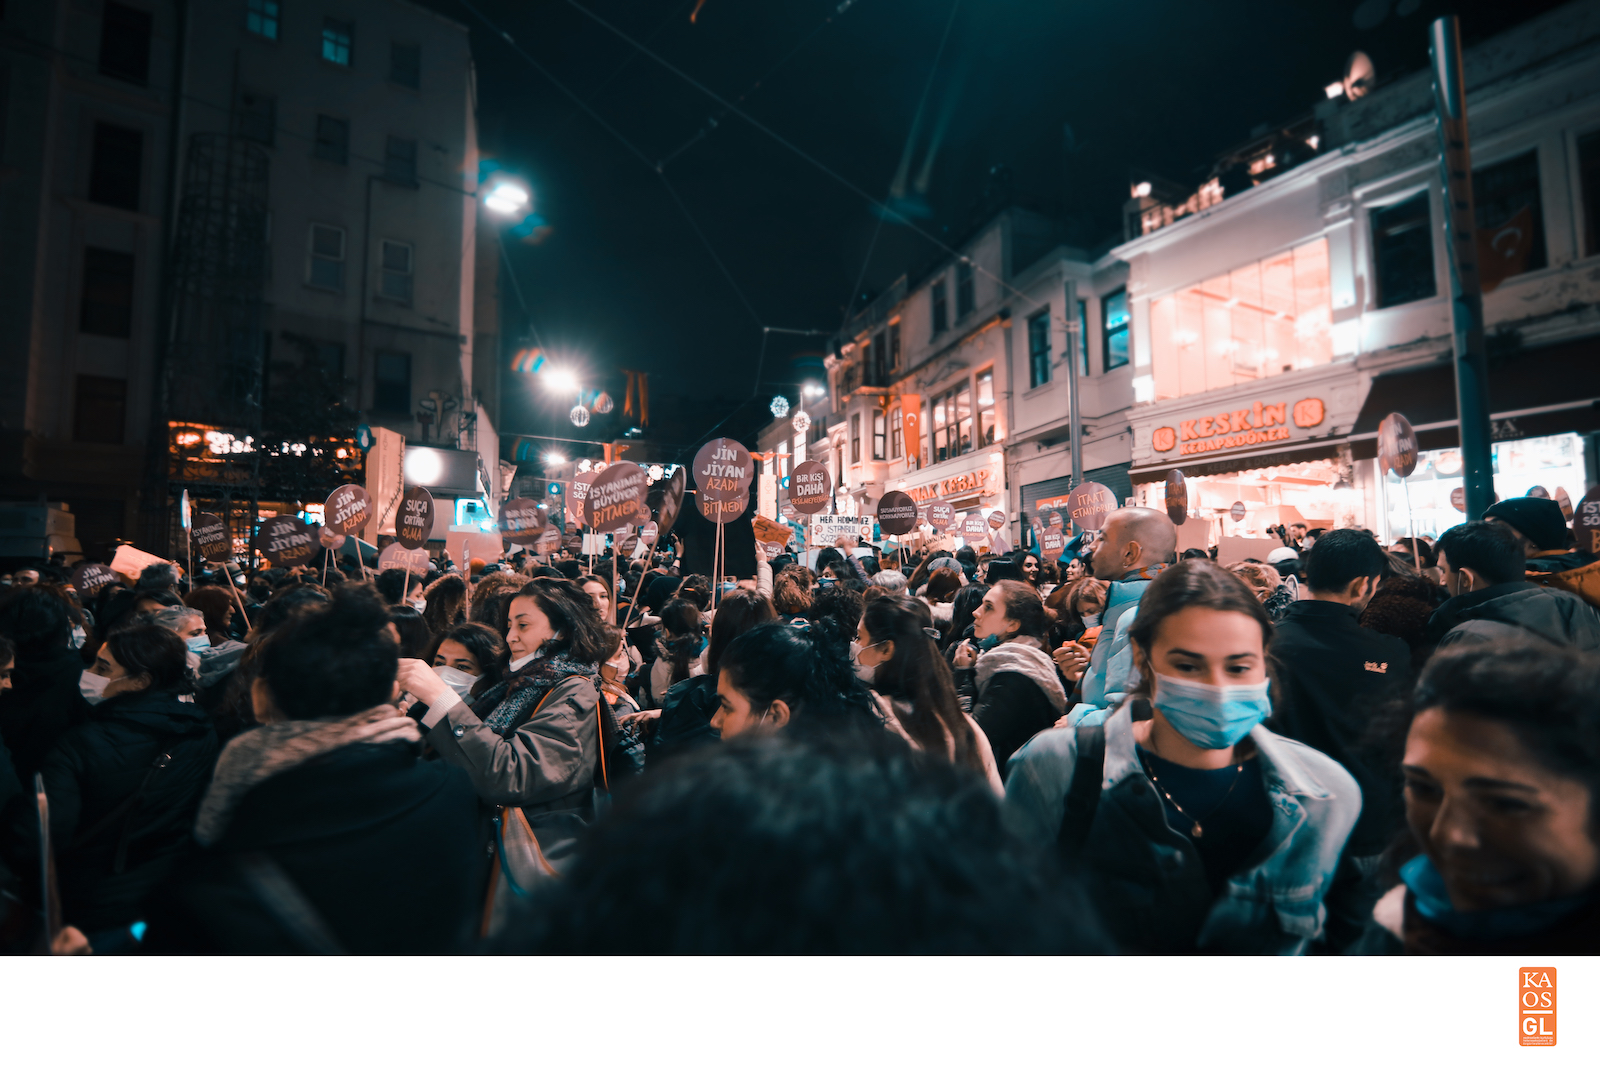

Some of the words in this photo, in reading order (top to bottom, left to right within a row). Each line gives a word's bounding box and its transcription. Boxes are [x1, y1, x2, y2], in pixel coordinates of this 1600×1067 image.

[1180, 401, 1286, 441] KESKİN
[1180, 427, 1290, 455] KEBAP&DÖNER
[712, 445, 737, 461] JİN
[702, 461, 745, 478] JİYAN
[796, 474, 808, 483] BİR
[810, 472, 824, 483] KİŞİ
[589, 473, 643, 499] İSYANIMIZ
[706, 477, 738, 492] AZADİ
[796, 483, 824, 496] DAHA
[941, 469, 990, 496] KEBAP
[335, 491, 356, 509] JİN
[593, 486, 640, 510] BÜYÜYOR
[1077, 490, 1105, 506] İTAAT
[334, 499, 367, 524] JİYAN
[405, 499, 428, 517] SUÇA
[1072, 503, 1116, 519] ETMİYORUZ
[343, 509, 367, 532] AZADİ
[404, 514, 425, 526] ORTAK
[820, 516, 834, 524] HER
[270, 522, 297, 537] JİN
[402, 527, 422, 541] OLMA
[268, 532, 312, 552] JİYAN
[82, 573, 114, 589] JİYAN
[83, 567, 102, 579] JİN
